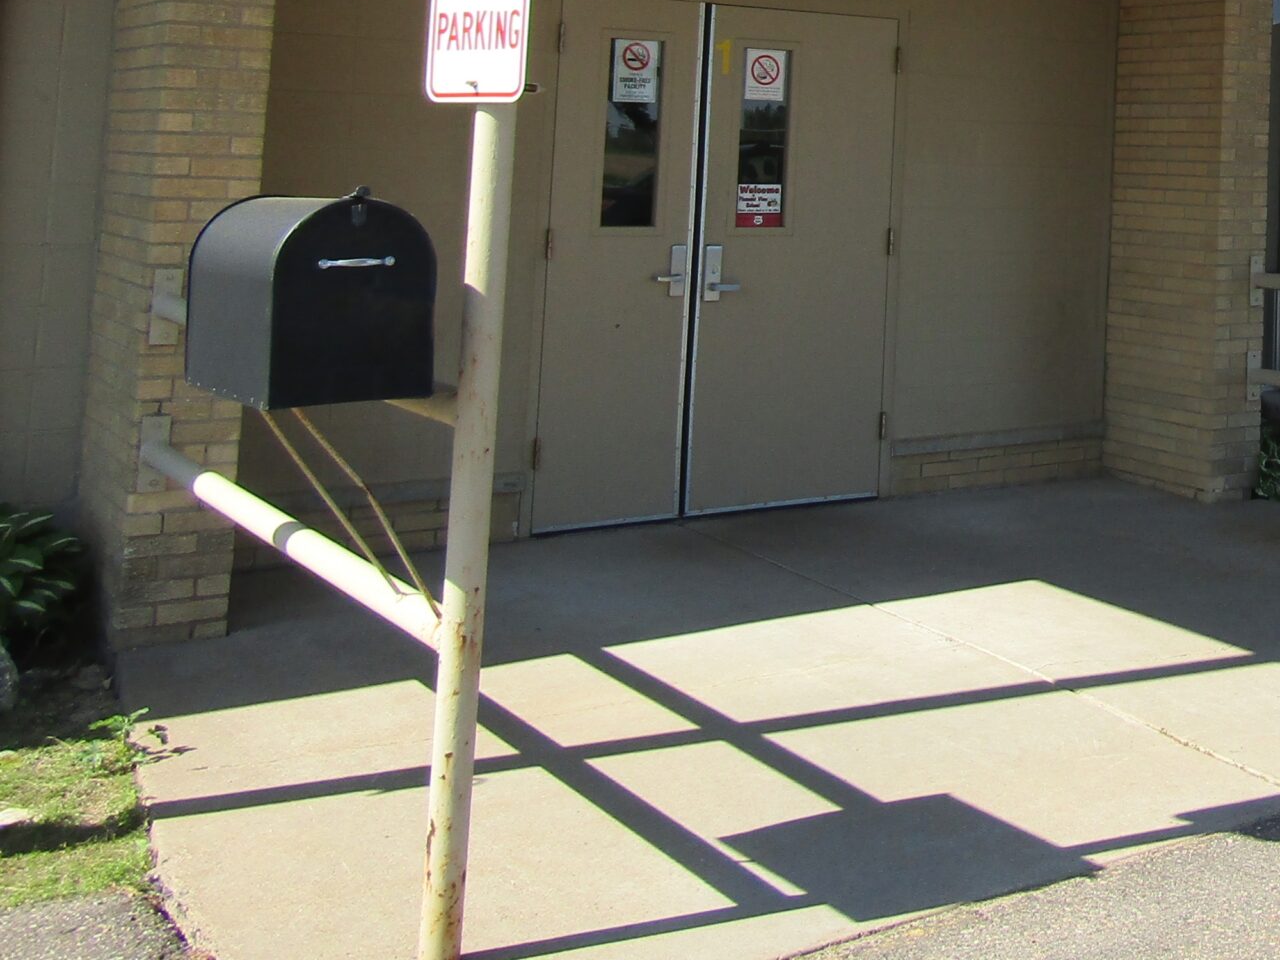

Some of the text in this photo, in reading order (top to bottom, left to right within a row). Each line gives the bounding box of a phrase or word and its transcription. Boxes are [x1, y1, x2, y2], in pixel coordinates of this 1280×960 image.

[436, 9, 520, 51] PARKING
[715, 39, 734, 75] 1
[739, 185, 780, 194] Welcome
